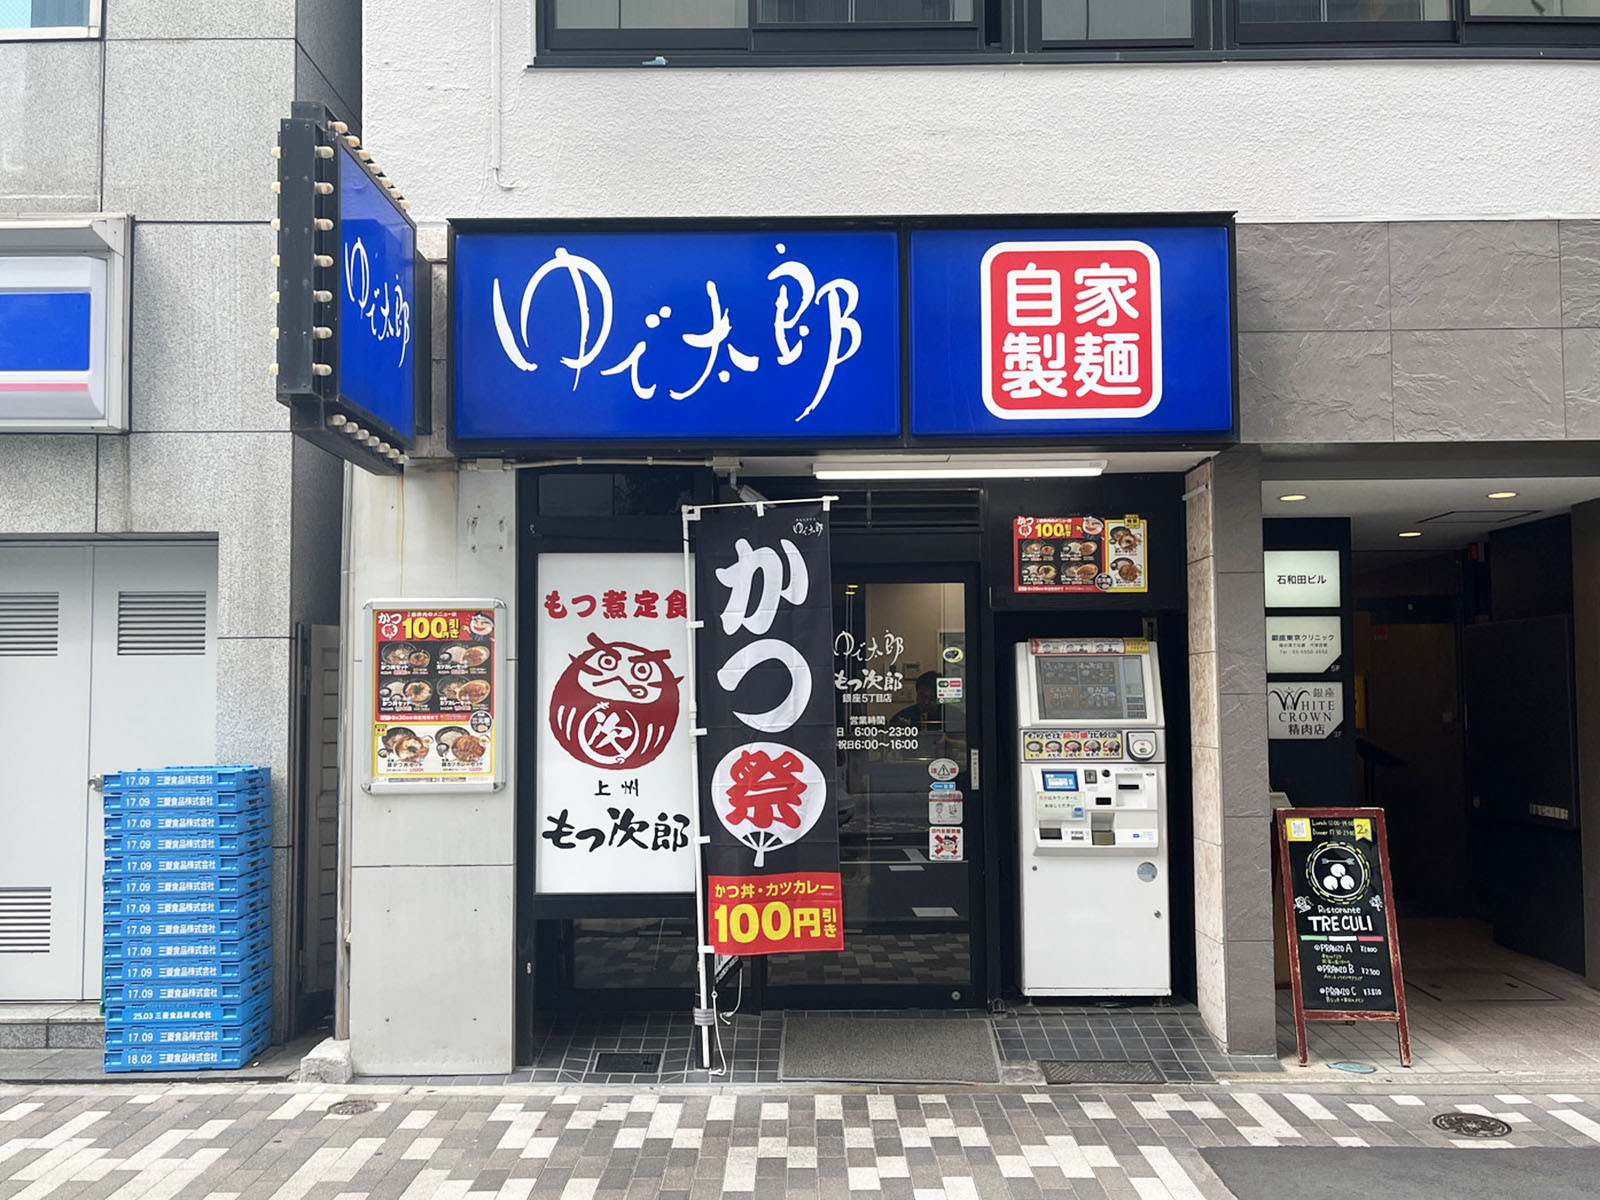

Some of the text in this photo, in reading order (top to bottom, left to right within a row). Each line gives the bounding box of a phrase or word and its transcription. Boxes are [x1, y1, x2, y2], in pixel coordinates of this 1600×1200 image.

[1005, 262, 1140, 329] 自家
[344, 236, 410, 369] ゆで太郎
[492, 243, 862, 422] ゆで太郎
[1001, 331, 1140, 400] 製麺
[1276, 574, 1327, 585] 石和田ビル
[543, 590, 688, 620] もつ煮定食
[378, 612, 402, 625] かつ
[833, 629, 905, 666] ゆで太郎
[833, 668, 904, 693] もつ次郎
[842, 693, 893, 703] 銀座5丁目店
[1313, 687, 1335, 698] 銀座
[849, 715, 886, 726] 営業時間
[1278, 711, 1333, 723] CROWN
[588, 711, 633, 750] 次
[836, 726, 844, 737] 日
[1288, 723, 1326, 736] 精肉店
[125, 776, 150, 785] 17.09
[594, 778, 640, 797] 上州
[125, 797, 150, 806] 17.09
[126, 818, 151, 828] 17.09
[542, 807, 690, 853] もつ次郎
[126, 840, 151, 849] 17.09
[126, 861, 152, 870] 17.09
[125, 882, 151, 891] 17.09
[714, 880, 835, 900] かつ丼・カツカレー
[125, 903, 151, 913] 17.09
[1317, 904, 1362, 914] Ristorante
[1307, 915, 1374, 932] TRE CULI
[126, 925, 152, 934] 17.09
[127, 946, 152, 956] 17.09
[1345, 943, 1353, 953] A
[127, 967, 153, 977] 17.09
[1348, 963, 1355, 974] B
[127, 988, 153, 998] 17.09
[1350, 986, 1357, 996] C
[133, 1011, 154, 1020] 25.03
[128, 1032, 153, 1042] 17.09
[127, 1053, 153, 1063] 18.02
